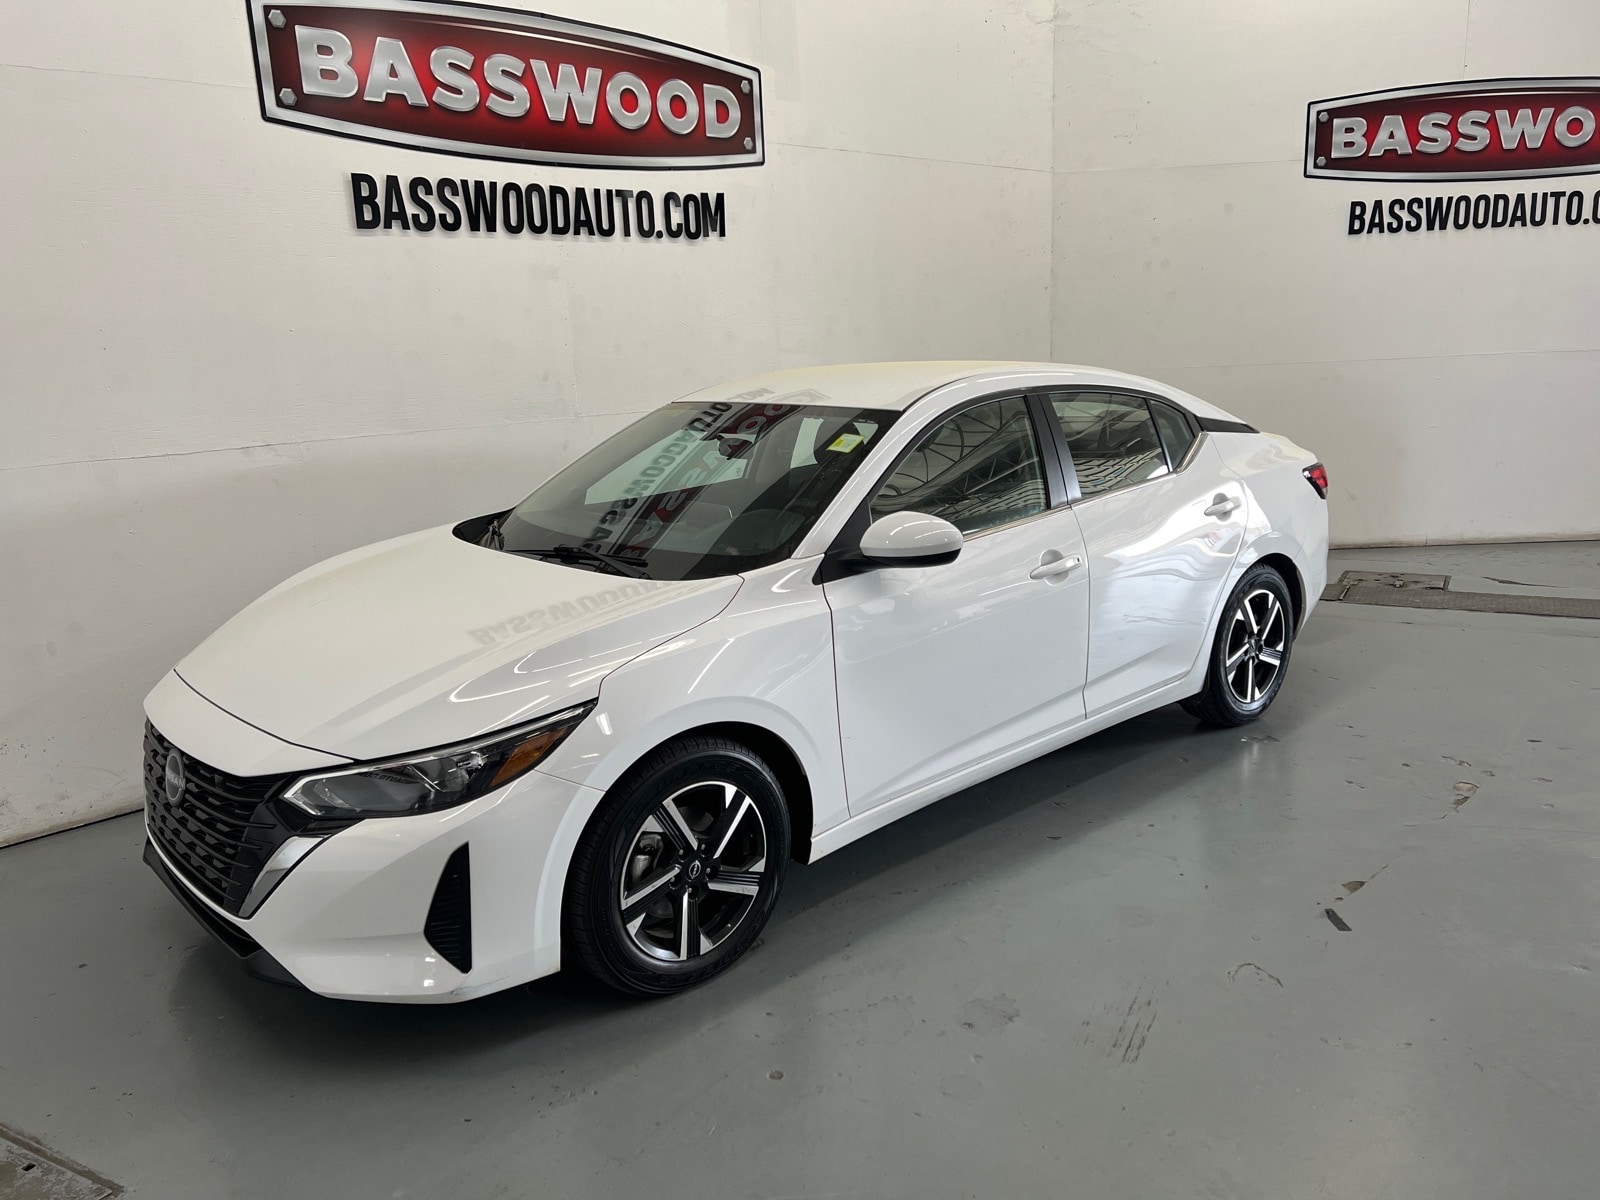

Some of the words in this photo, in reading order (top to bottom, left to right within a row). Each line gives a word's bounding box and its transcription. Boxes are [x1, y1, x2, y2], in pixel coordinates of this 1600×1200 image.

[294, 25, 741, 139] BASSWOOD
[1331, 105, 1596, 159] BASSWO
[350, 172, 726, 240] BASSWOODAUTO.COM
